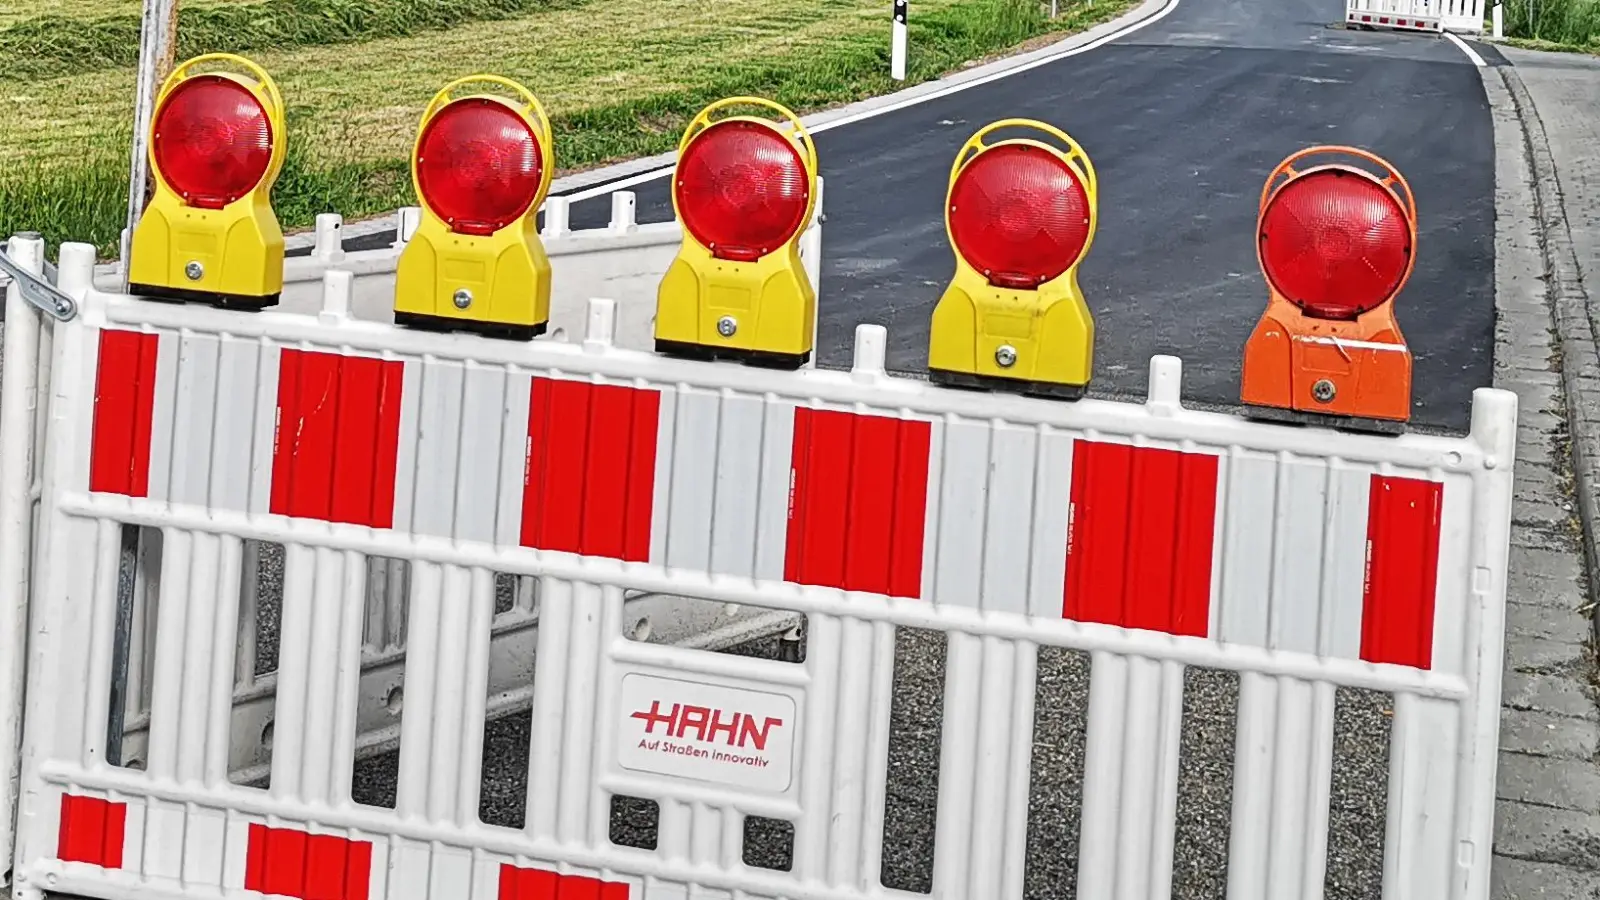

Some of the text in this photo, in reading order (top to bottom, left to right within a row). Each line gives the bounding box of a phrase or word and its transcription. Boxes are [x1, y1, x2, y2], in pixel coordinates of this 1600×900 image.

[630, 700, 783, 750] HAHN
[638, 739, 769, 767] Auf Straßen innovativ
